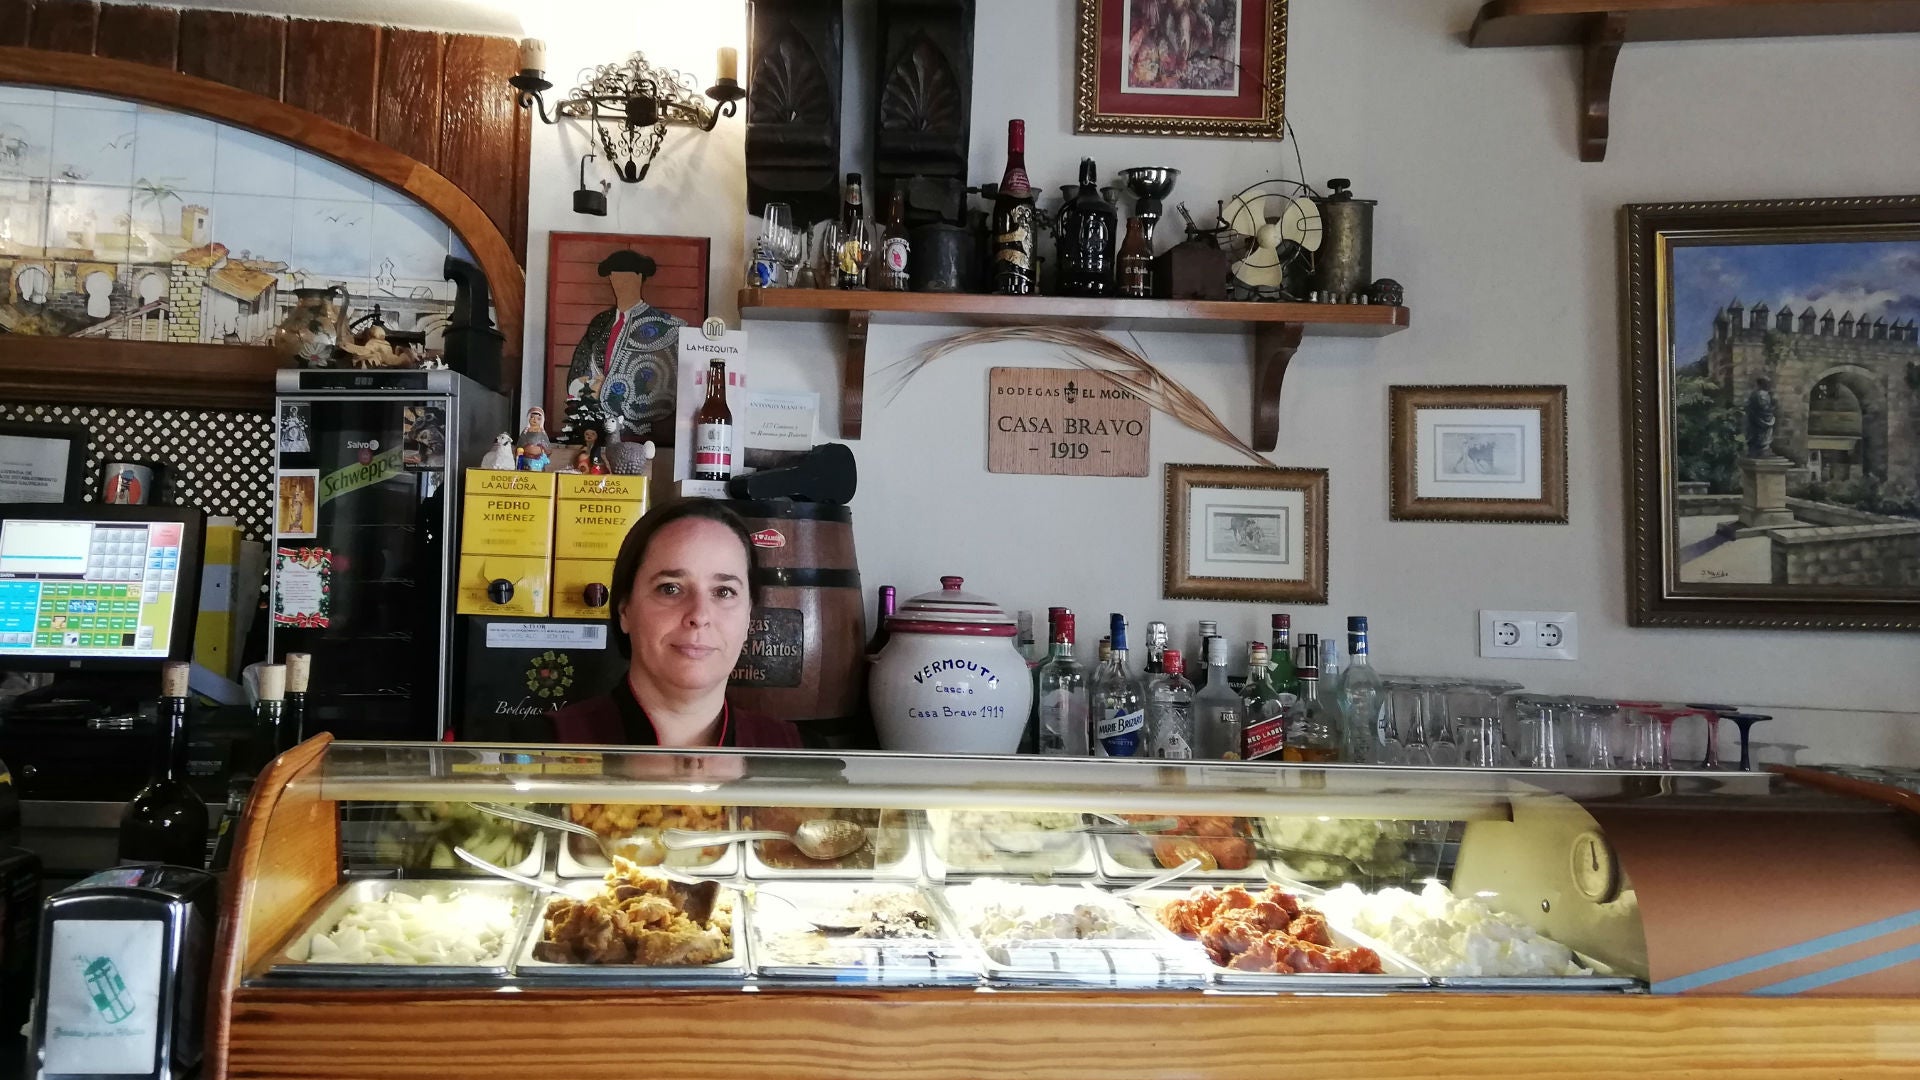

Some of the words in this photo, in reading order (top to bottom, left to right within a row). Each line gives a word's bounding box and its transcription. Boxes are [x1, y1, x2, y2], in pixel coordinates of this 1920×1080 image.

[686, 343, 696, 351] LA
[697, 344, 738, 354] MEZQUITA
[997, 387, 1060, 397] BODEGAS
[1082, 388, 1095, 398] EL
[1099, 389, 1142, 400] MON
[997, 415, 1054, 434] CASA
[1063, 418, 1143, 436] BRAVO
[1049, 442, 1089, 459] 1919
[481, 481, 494, 489] LA
[495, 482, 537, 491] AURORA
[574, 486, 586, 494] LA
[588, 486, 629, 495] AURORA
[487, 501, 530, 510] PEDRO
[579, 504, 621, 513] PEDRO
[748, 619, 770, 635] gas
[741, 642, 749, 656] s
[751, 639, 798, 657] Martos
[730, 664, 766, 681] oriles
[935, 685, 974, 695] Caso
[495, 695, 543, 721] Bodegas
[551, 700, 568, 712] N
[908, 707, 938, 718] Casa
[942, 706, 977, 717] Bravo
[980, 705, 1005, 718] 1919
[1099, 722, 1117, 734] MARIE
[1247, 734, 1262, 744] RED
[1262, 726, 1283, 739] LABEL
